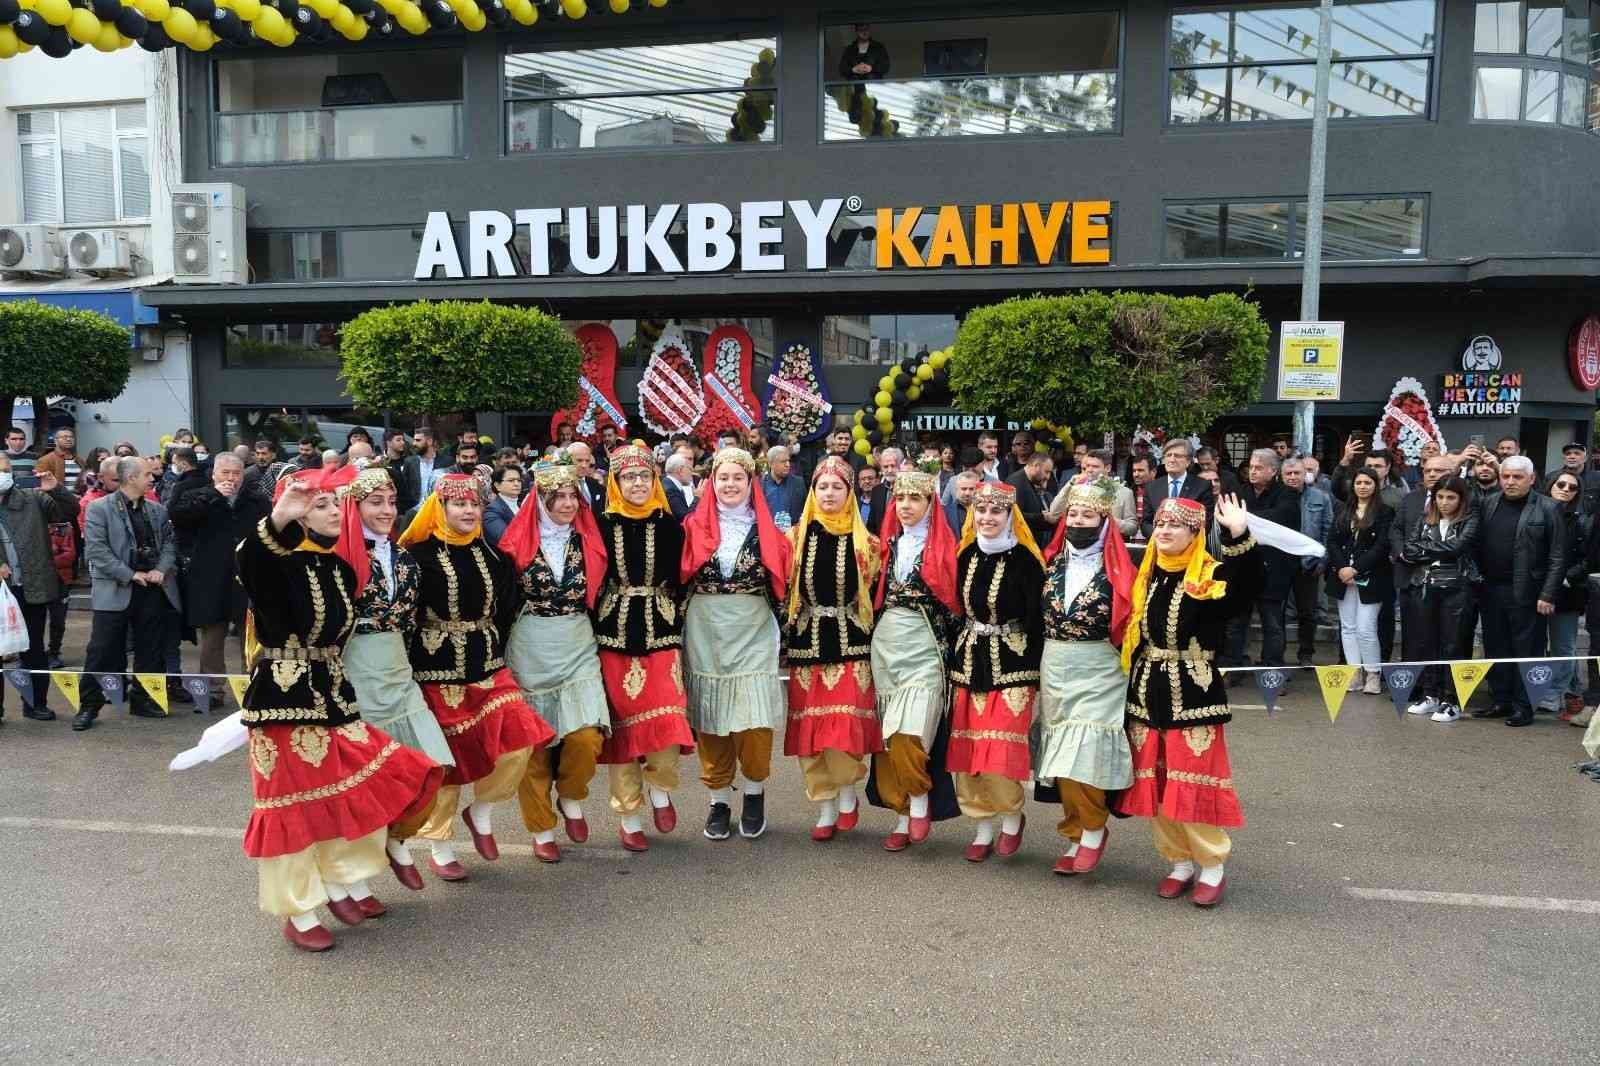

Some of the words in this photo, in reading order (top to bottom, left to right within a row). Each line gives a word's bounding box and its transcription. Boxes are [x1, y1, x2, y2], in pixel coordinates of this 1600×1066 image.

[876, 201, 1112, 268] KAHVE
[1305, 350, 1317, 362] P
[1444, 388, 1521, 401] HEYECAN
